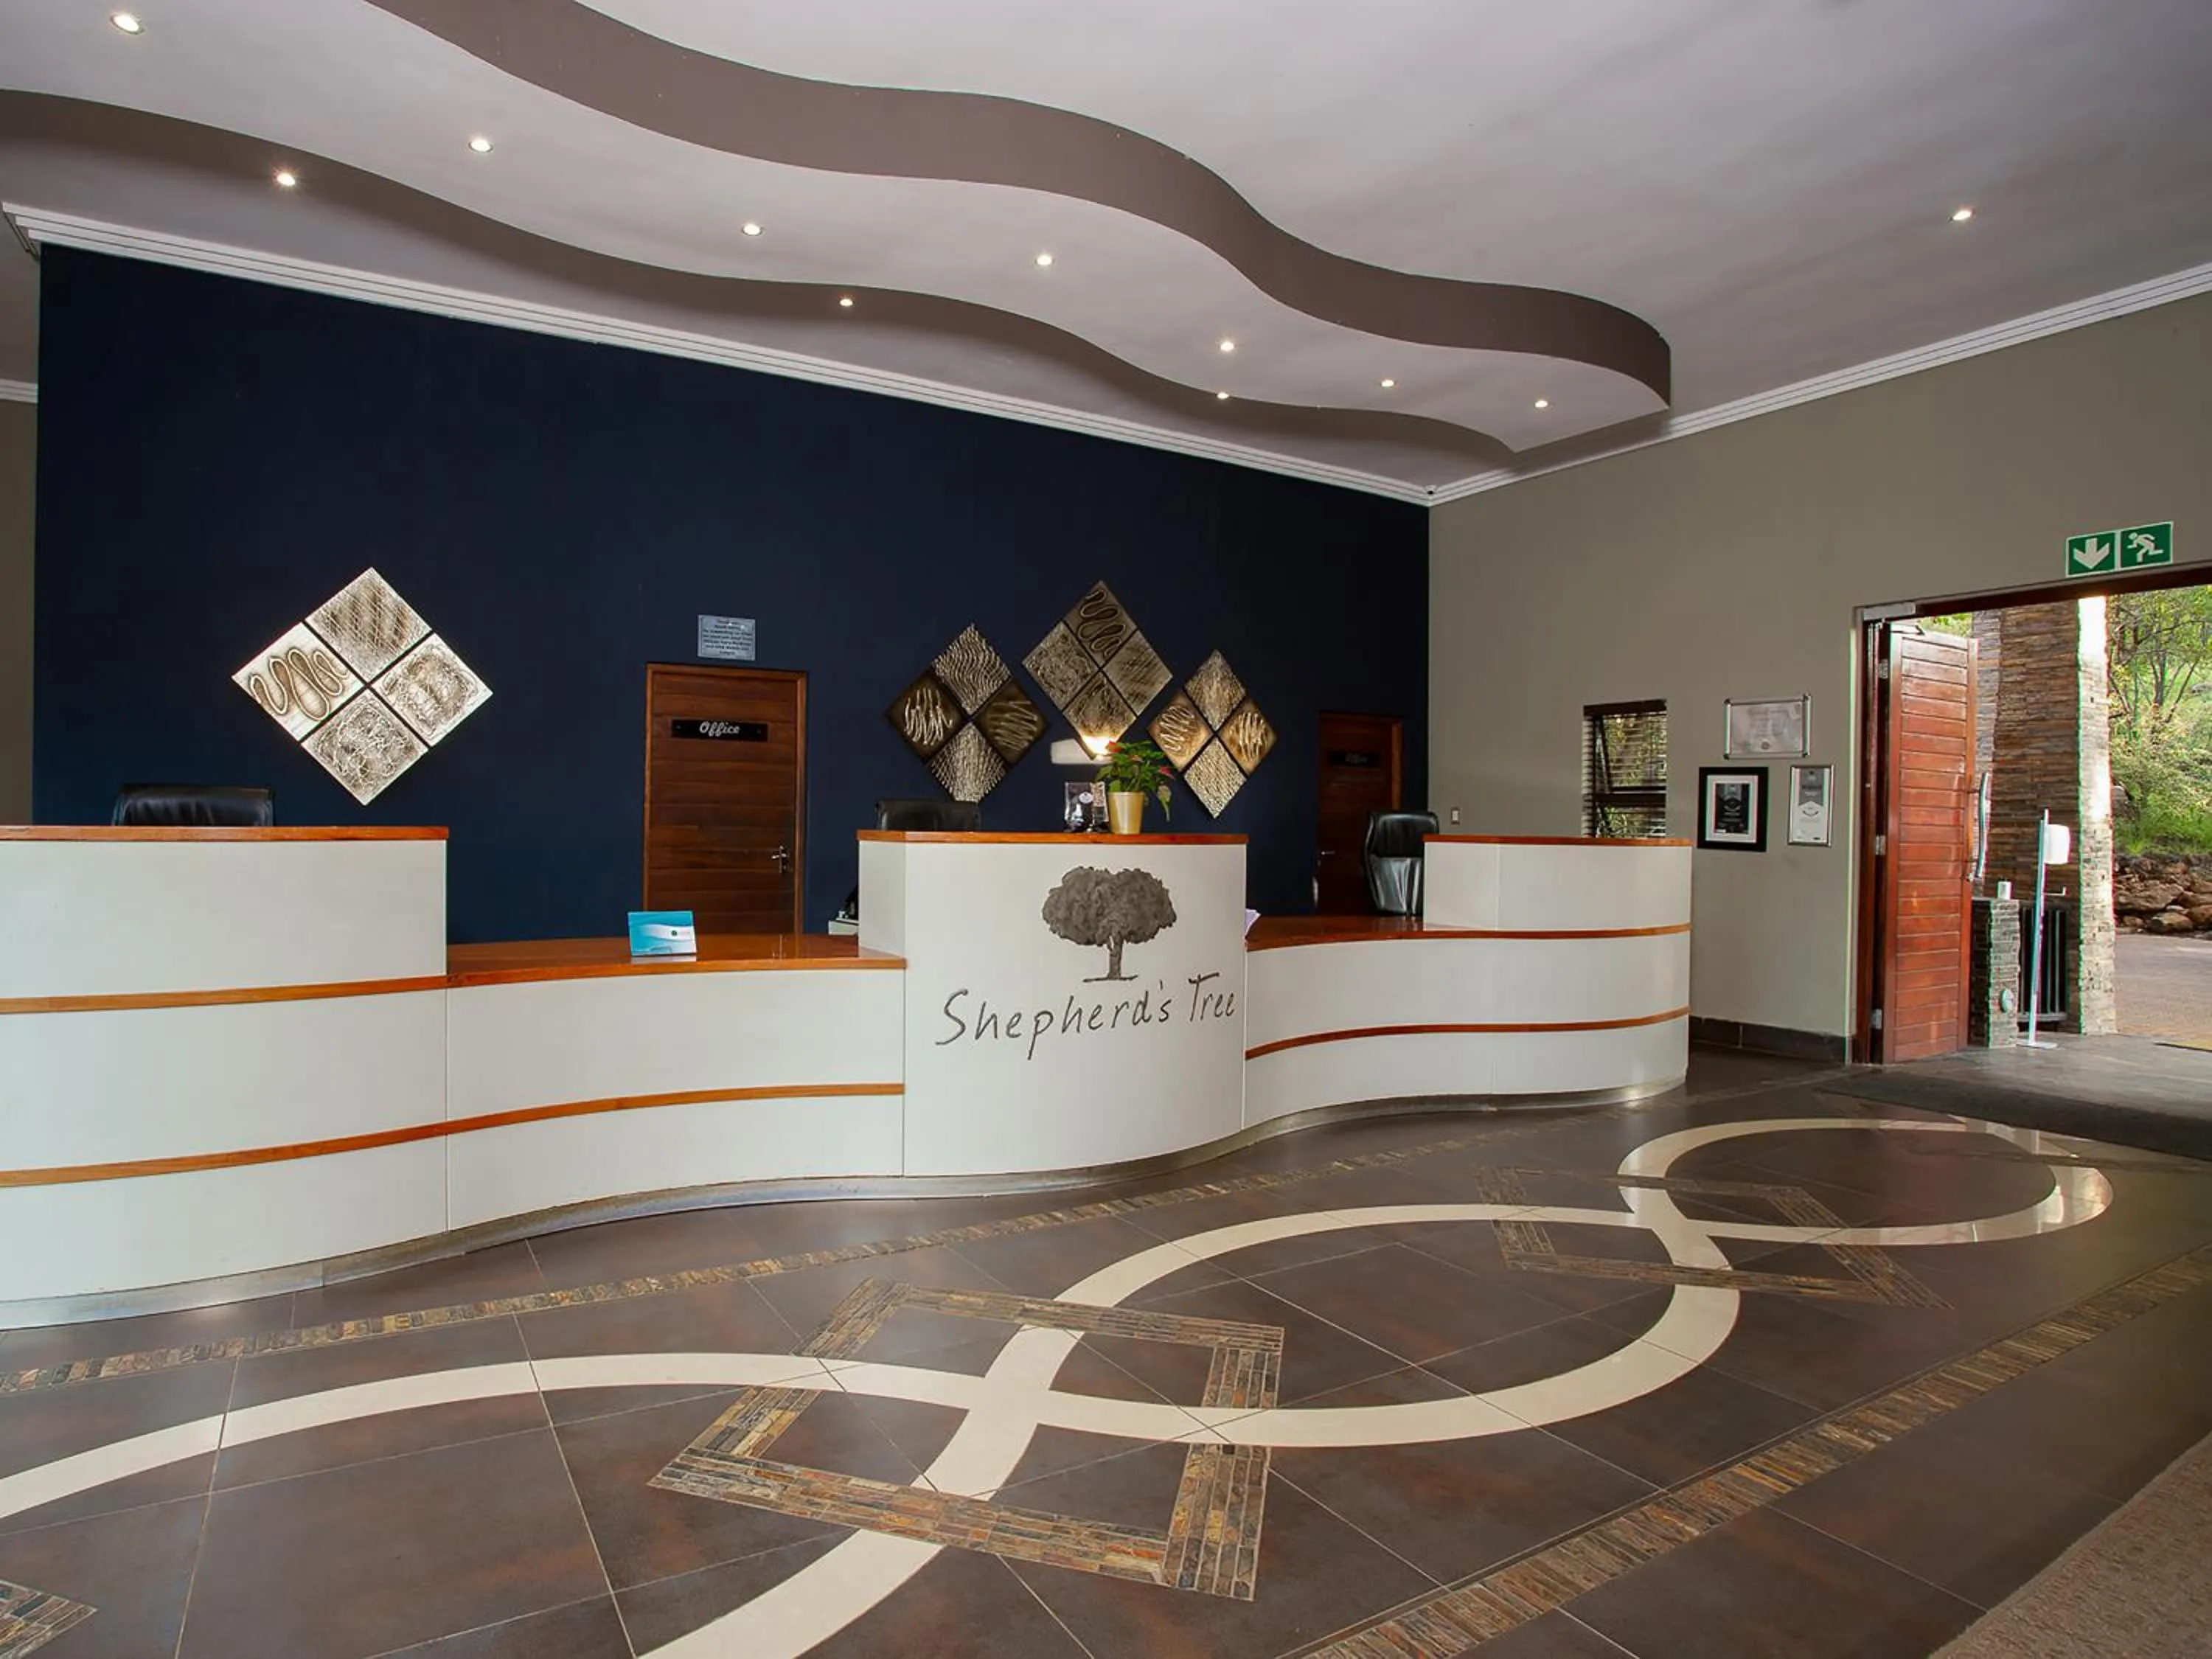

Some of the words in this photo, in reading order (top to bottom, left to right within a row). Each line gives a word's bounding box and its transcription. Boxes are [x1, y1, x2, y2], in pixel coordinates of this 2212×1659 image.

[699, 721, 740, 737] Office
[936, 980, 1172, 1060] Shepherd's
[1189, 972, 1236, 1022] Tree
